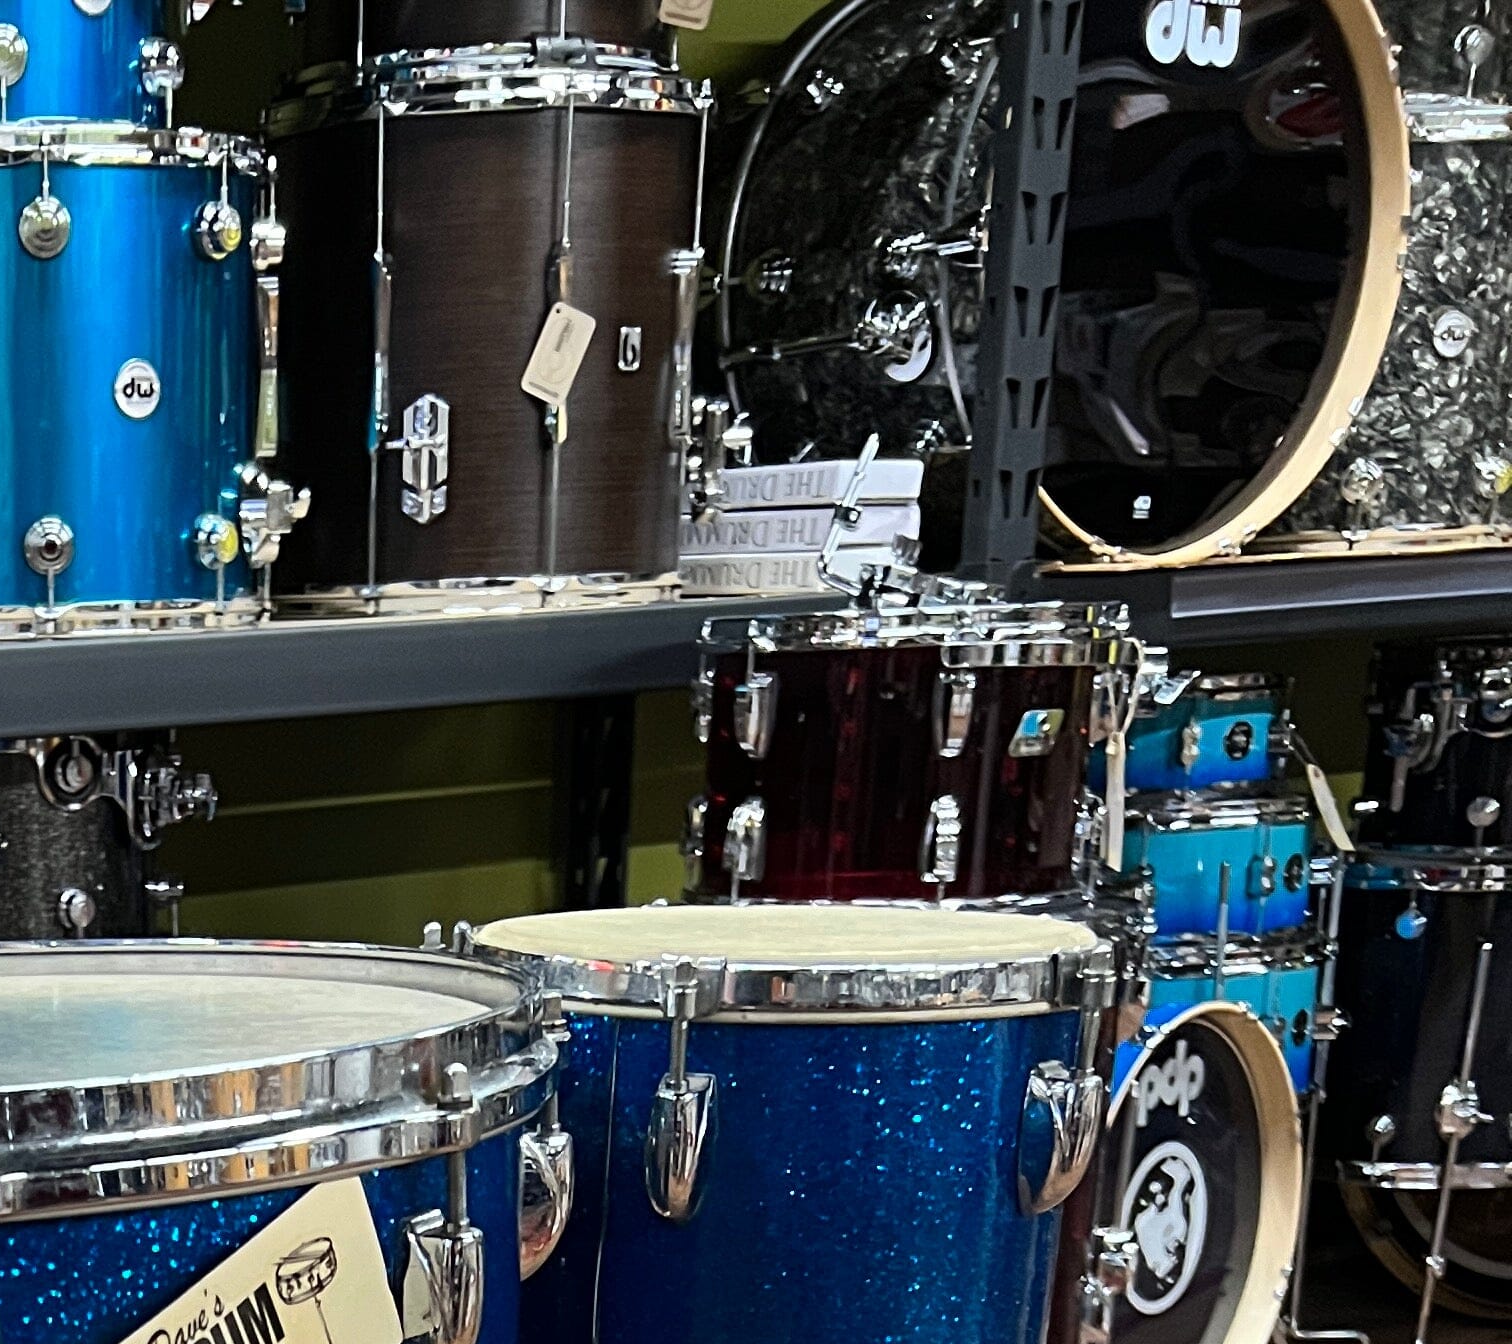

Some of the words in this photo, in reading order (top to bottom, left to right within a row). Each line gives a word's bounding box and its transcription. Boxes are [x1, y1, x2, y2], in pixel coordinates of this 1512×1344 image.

[1146, 0, 1242, 68] dw
[123, 377, 155, 399] dw
[785, 470, 828, 499] THE
[778, 516, 820, 546] THE
[771, 559, 813, 588] THE
[1137, 1039, 1206, 1128] pdp
